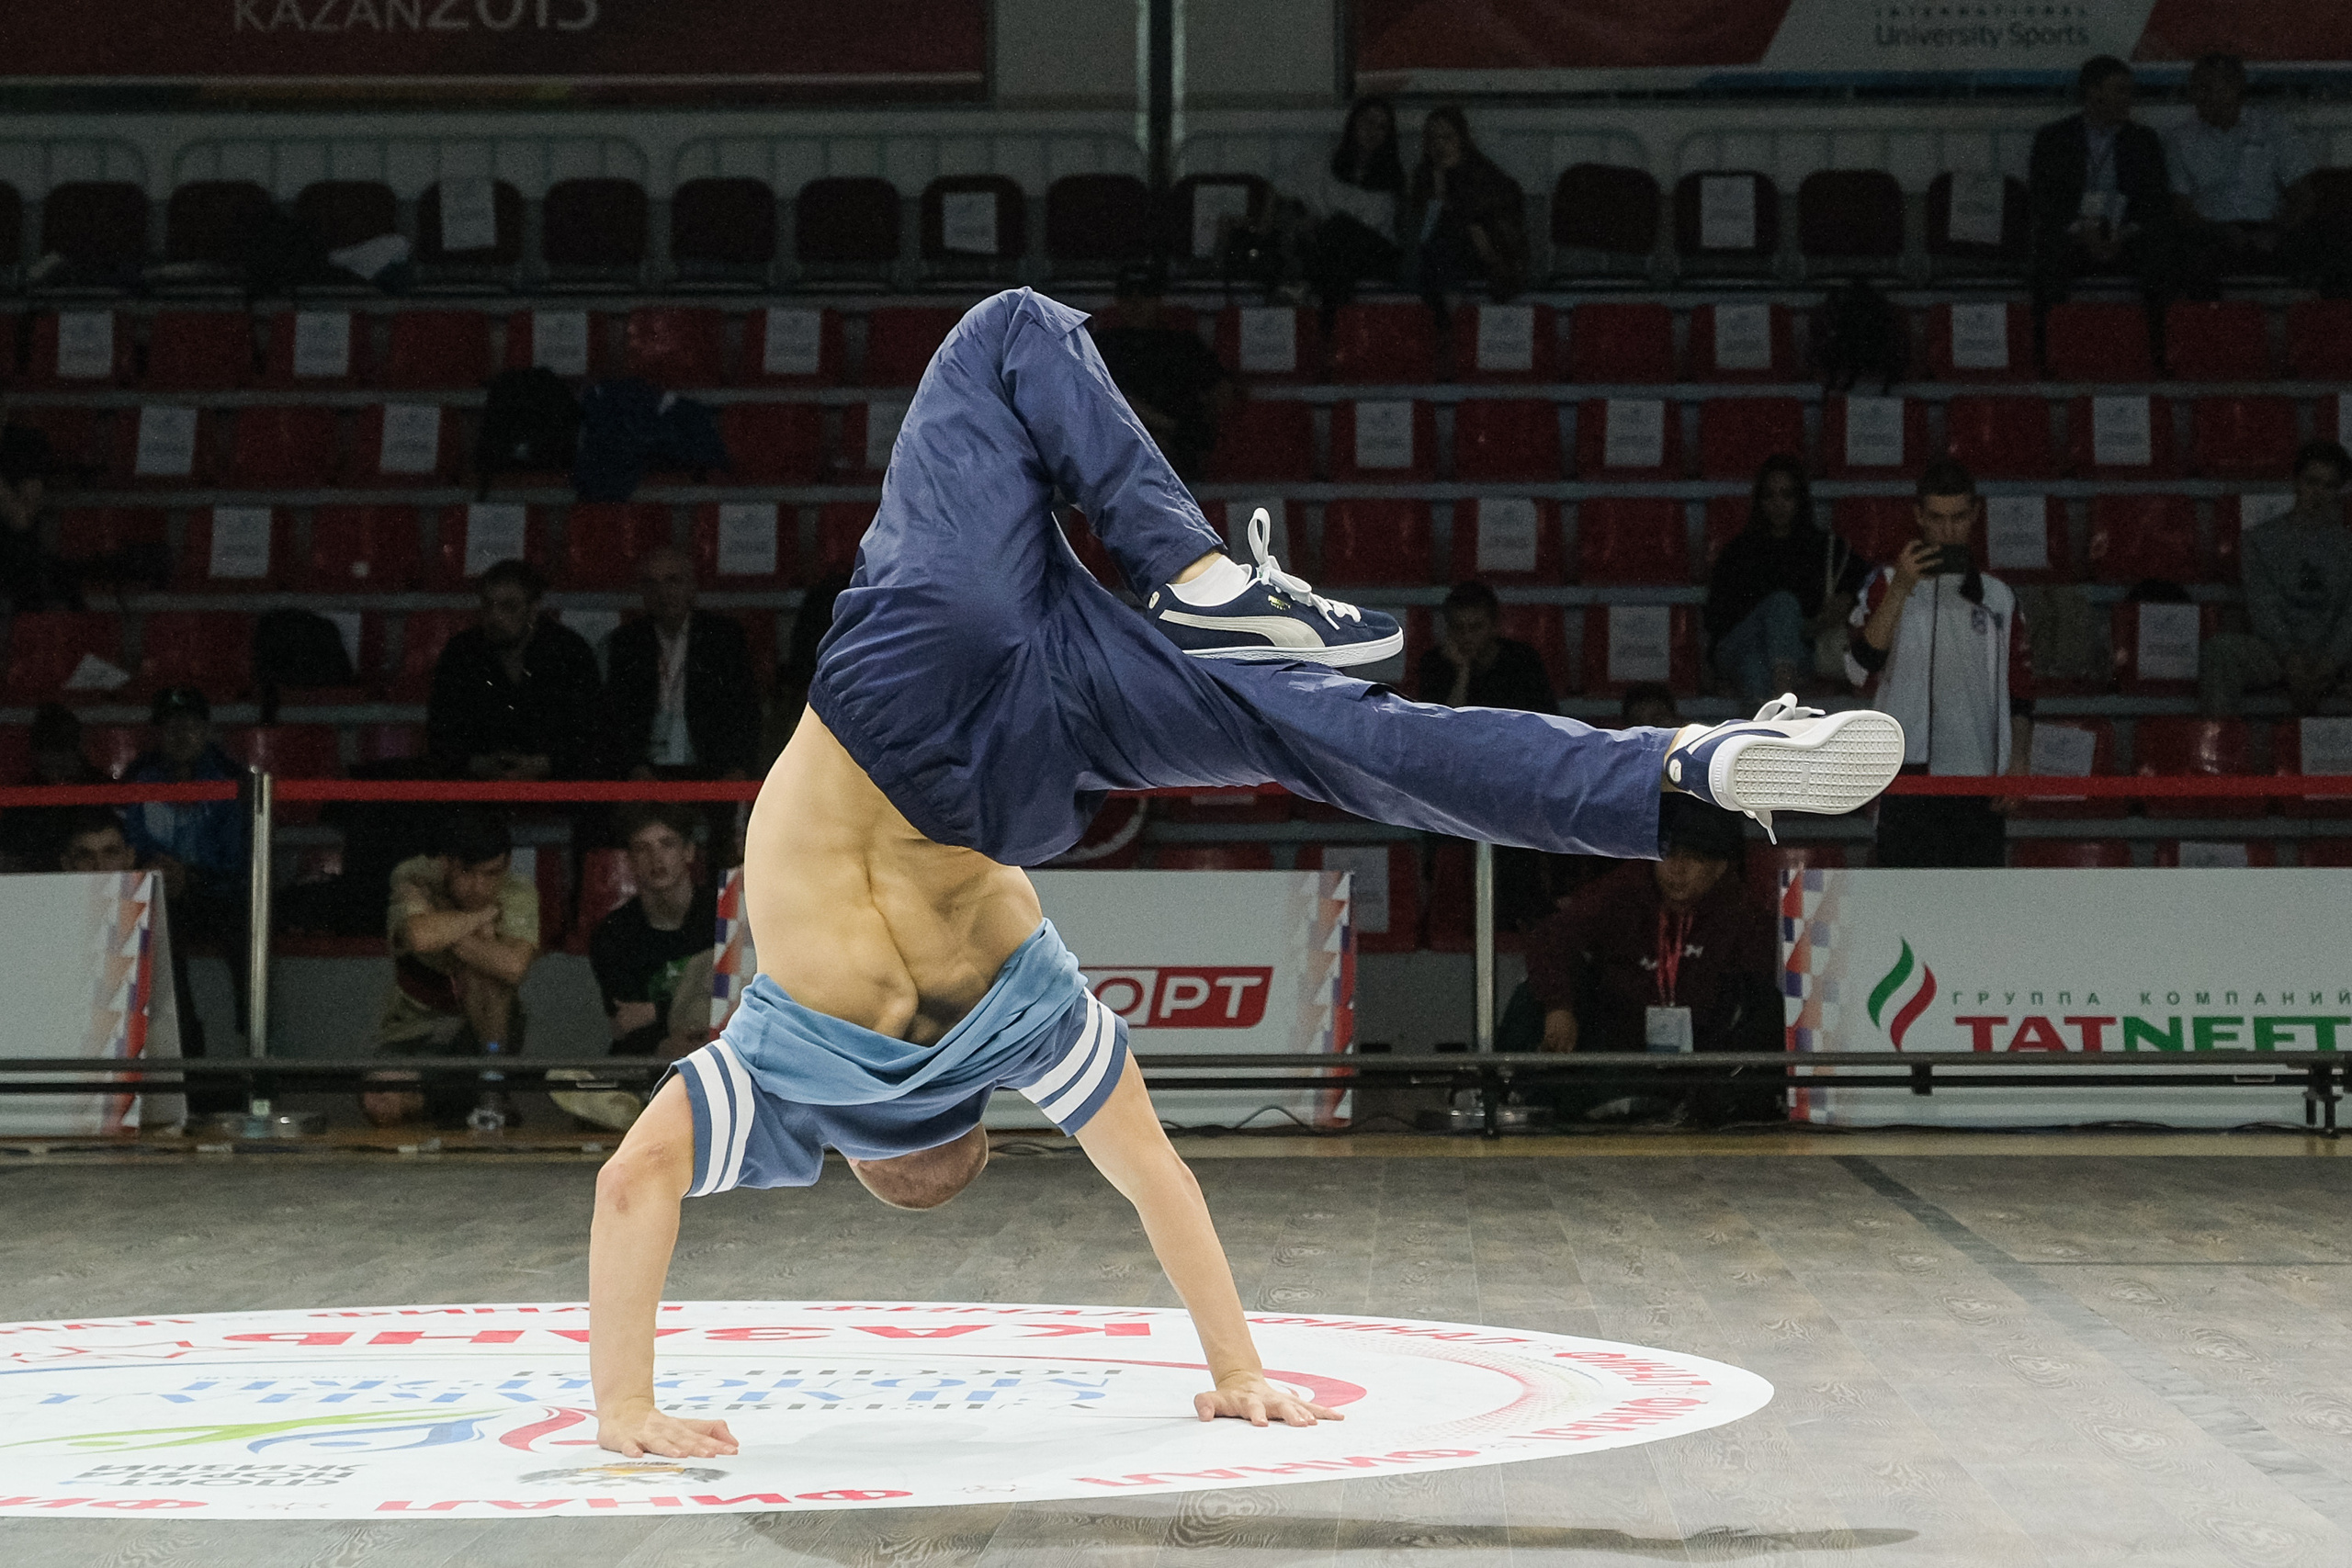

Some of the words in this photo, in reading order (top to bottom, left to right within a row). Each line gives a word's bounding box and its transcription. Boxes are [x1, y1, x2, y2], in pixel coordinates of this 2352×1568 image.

[1875, 23, 2004, 49] University
[2007, 21, 2090, 51] Sports
[1093, 976, 1263, 1019] ОРТ
[1952, 991, 2101, 1006] ГРУППА
[2140, 988, 2351, 1006] КОМПАНИЙ
[805, 1305, 1161, 1317] ФИНАЛ
[1247, 1317, 1534, 1344] ФИНАЛ
[1554, 1351, 1712, 1386] ФИНАЛ
[1505, 1397, 1709, 1441] ФИНАЛ
[89, 1463, 370, 1472] ЖИЗНИ
[1072, 1450, 1480, 1487] ФИНАЛ
[105, 1479, 340, 1487] СПОРТ
[375, 1489, 913, 1512] ФИНАЛ
